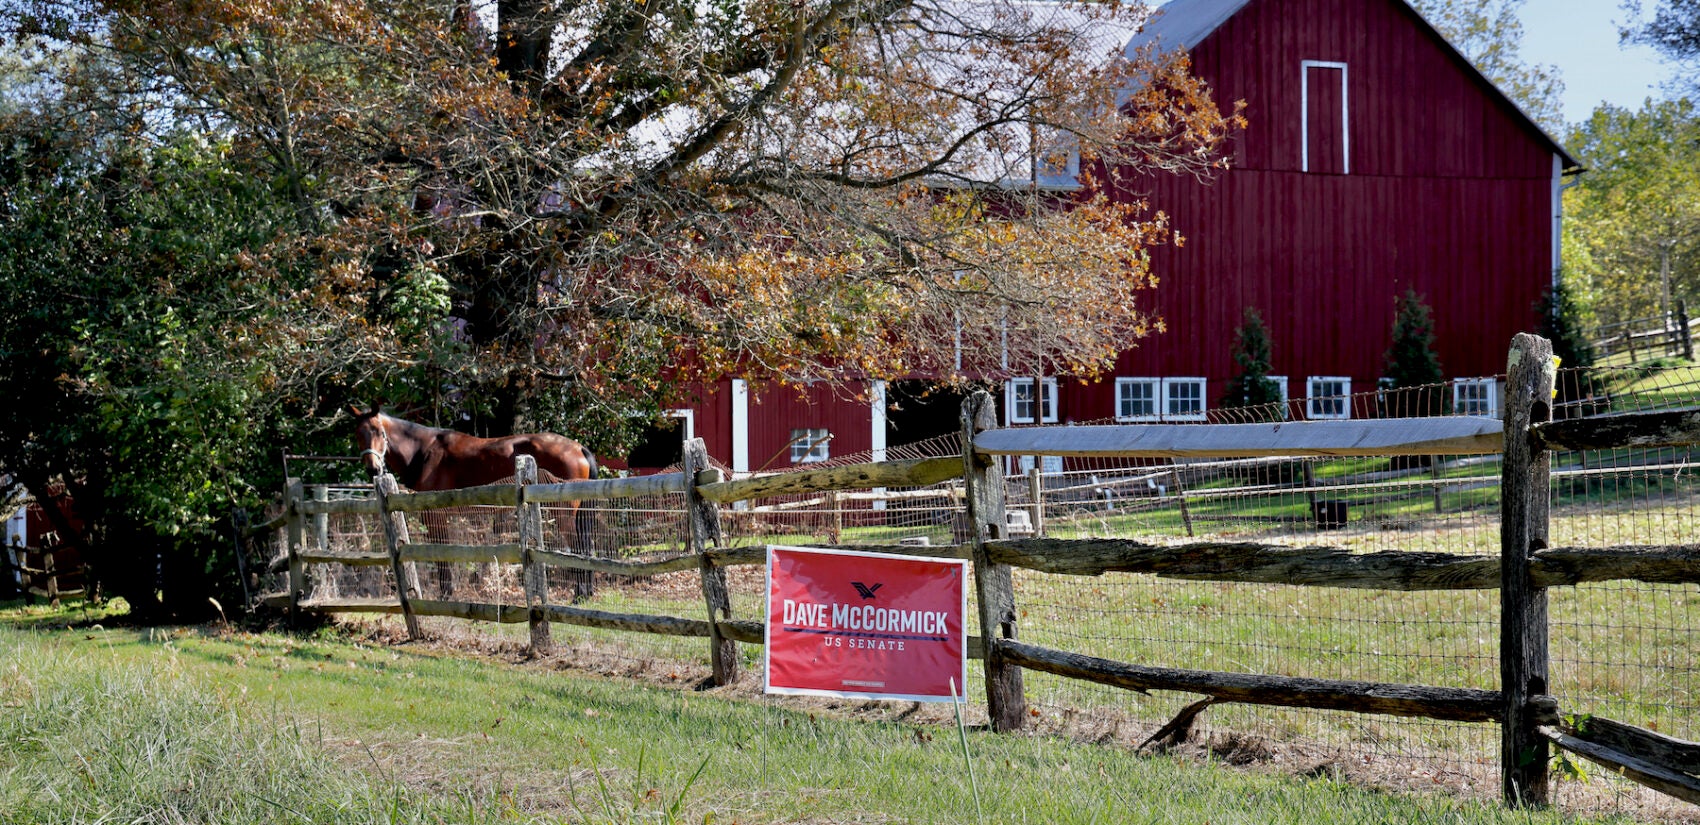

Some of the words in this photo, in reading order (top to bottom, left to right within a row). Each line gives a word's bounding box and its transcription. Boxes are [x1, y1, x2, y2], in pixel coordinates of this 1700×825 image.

[783, 599, 828, 627] DAVE
[824, 636, 842, 647] US
[849, 639, 905, 651] SENATE
